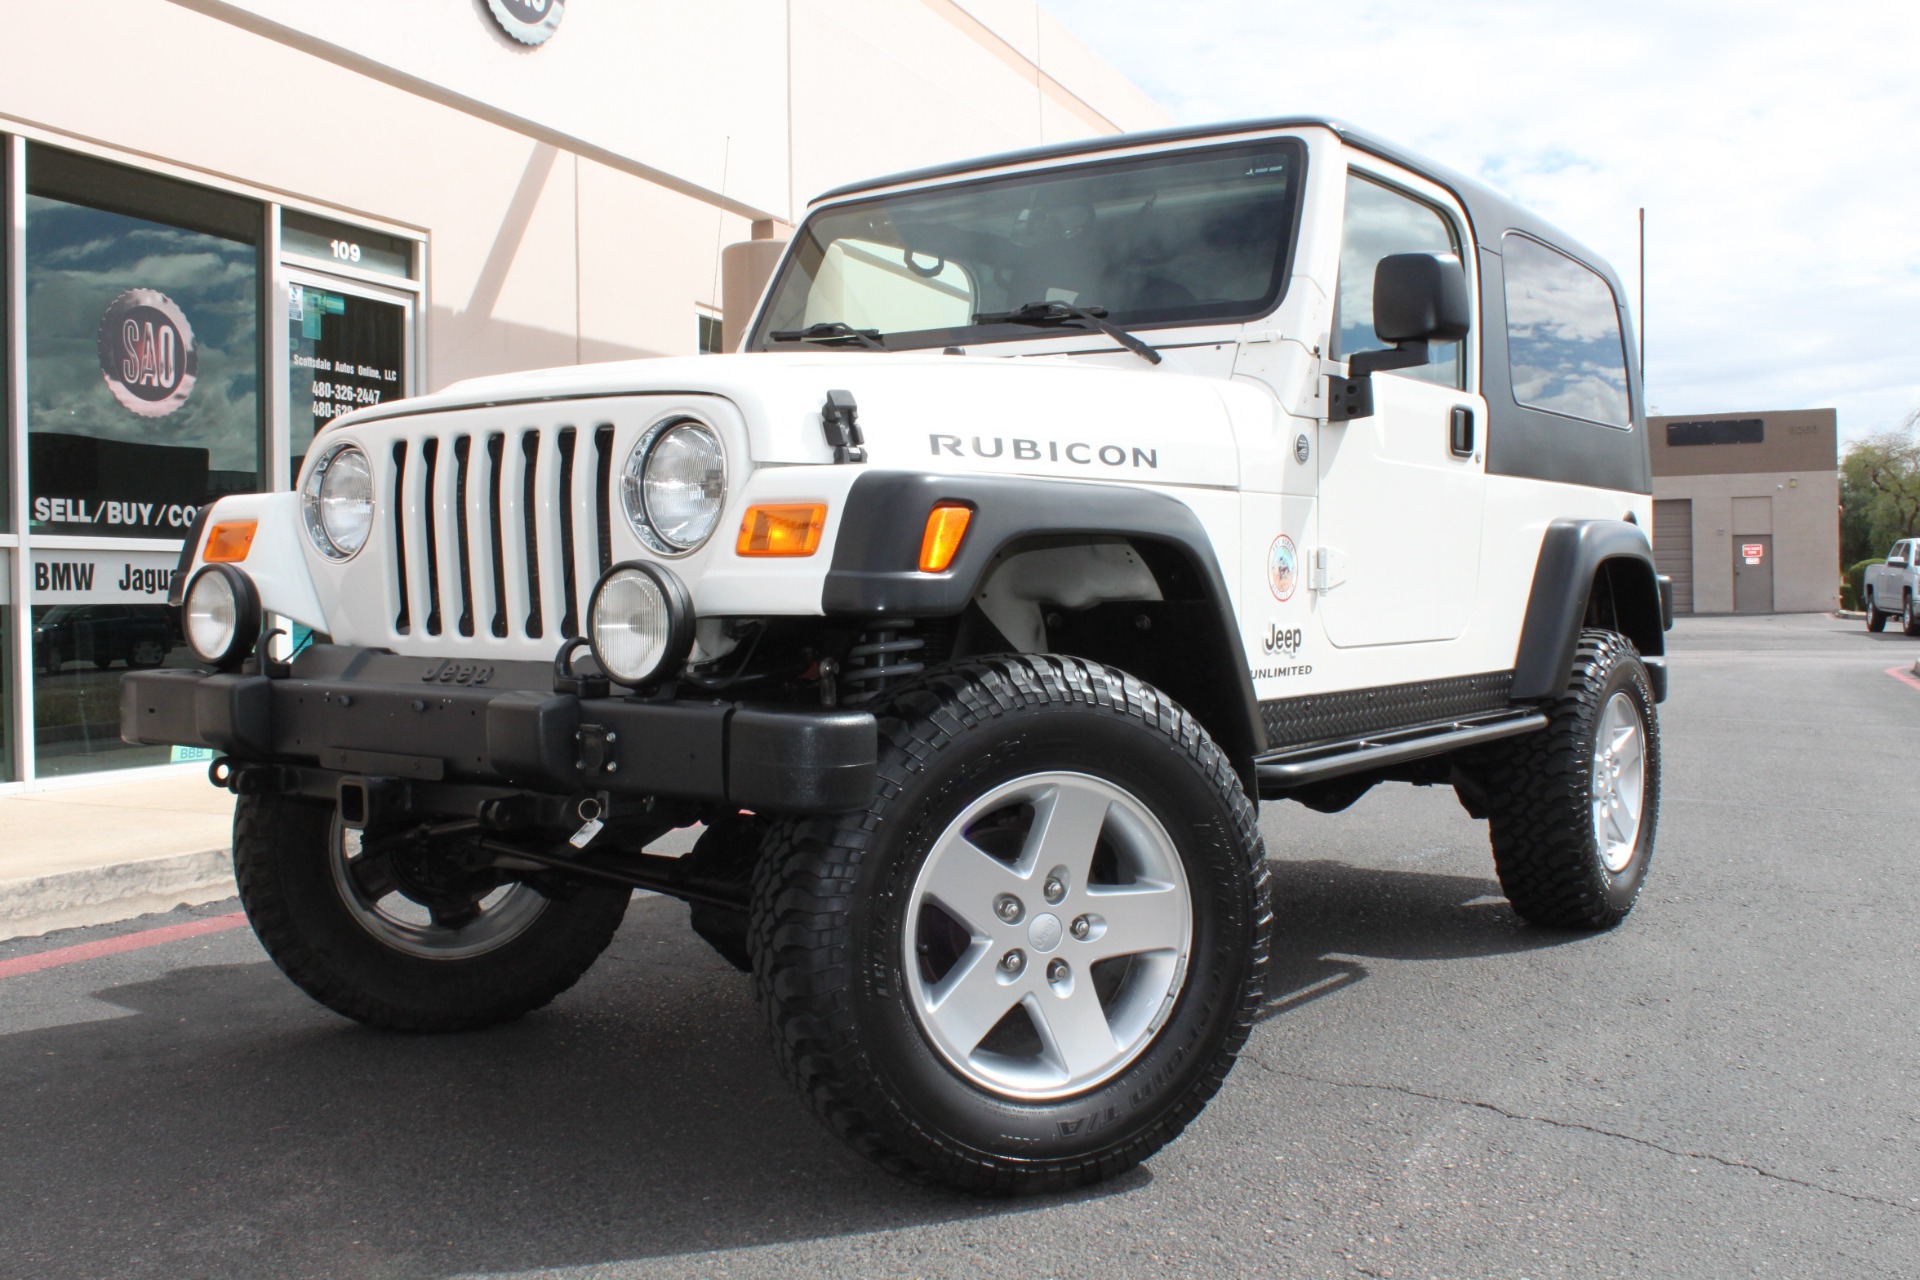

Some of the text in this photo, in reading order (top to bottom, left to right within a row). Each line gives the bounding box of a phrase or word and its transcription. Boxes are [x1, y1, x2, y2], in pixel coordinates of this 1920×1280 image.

[330, 239, 361, 263] 109
[122, 318, 176, 390] SAO
[293, 354, 397, 381] Scottsdale Autos Online, LLC
[311, 380, 381, 405] 480-326-2447
[929, 433, 1158, 469] RUBICON
[35, 562, 95, 591] BMW
[1265, 623, 1302, 653] Jeep
[422, 658, 495, 687] Jeep
[1251, 664, 1313, 680] UNLIMITED
[180, 748, 204, 759] BBB
